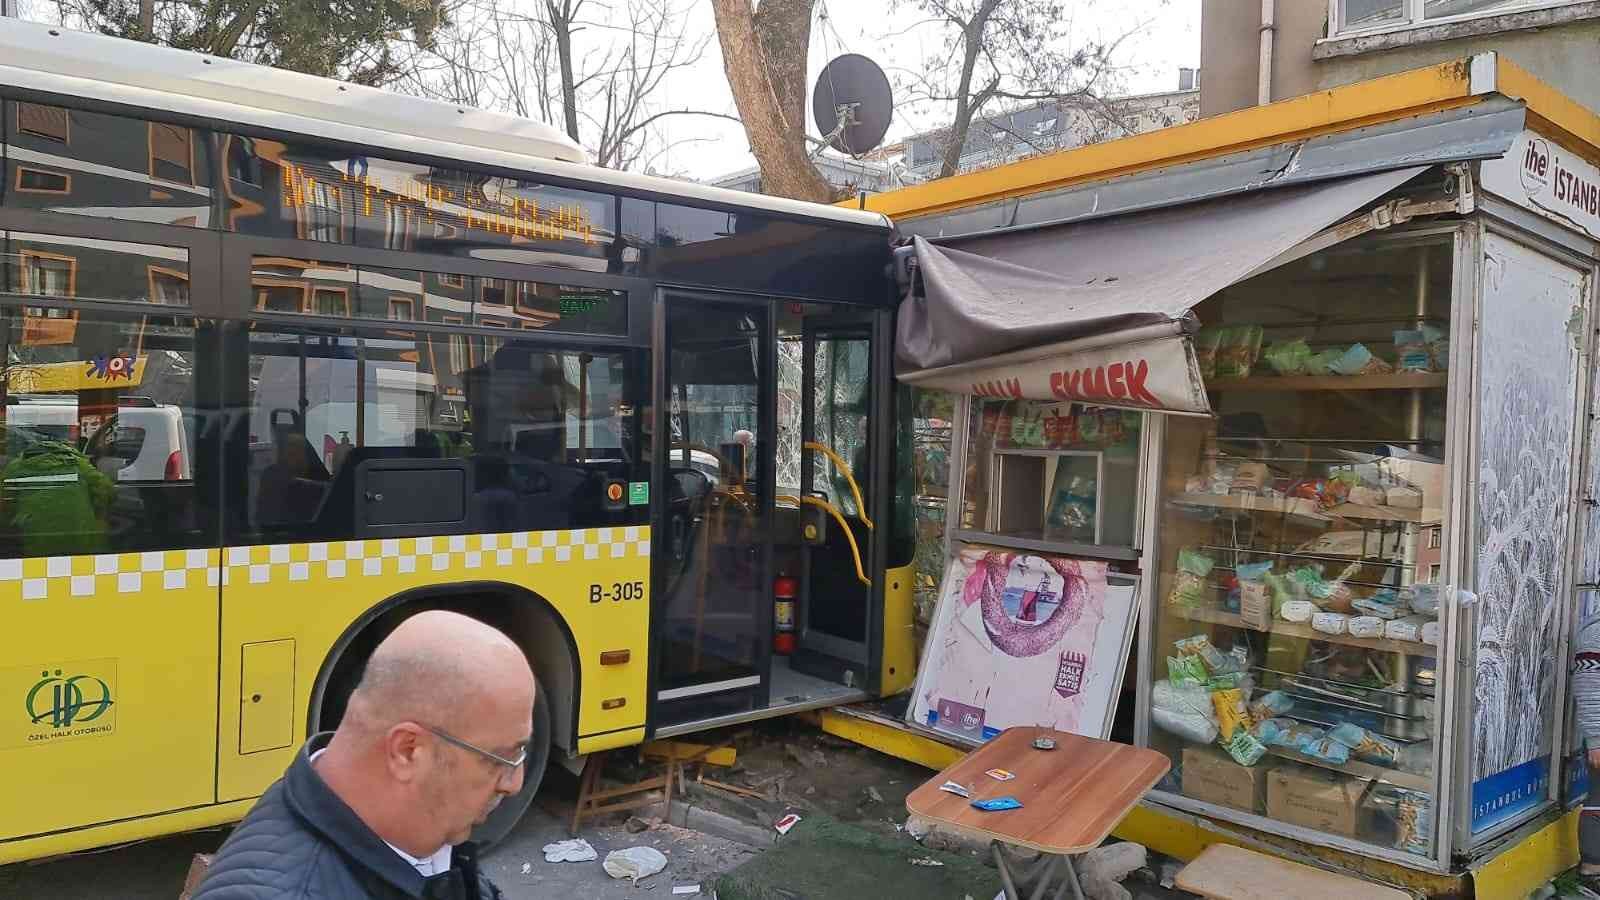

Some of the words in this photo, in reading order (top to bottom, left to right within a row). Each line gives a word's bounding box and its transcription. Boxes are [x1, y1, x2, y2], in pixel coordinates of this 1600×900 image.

[1525, 140, 1546, 176] ihe
[590, 582, 643, 602] B-305
[51, 730, 73, 739] HALK
